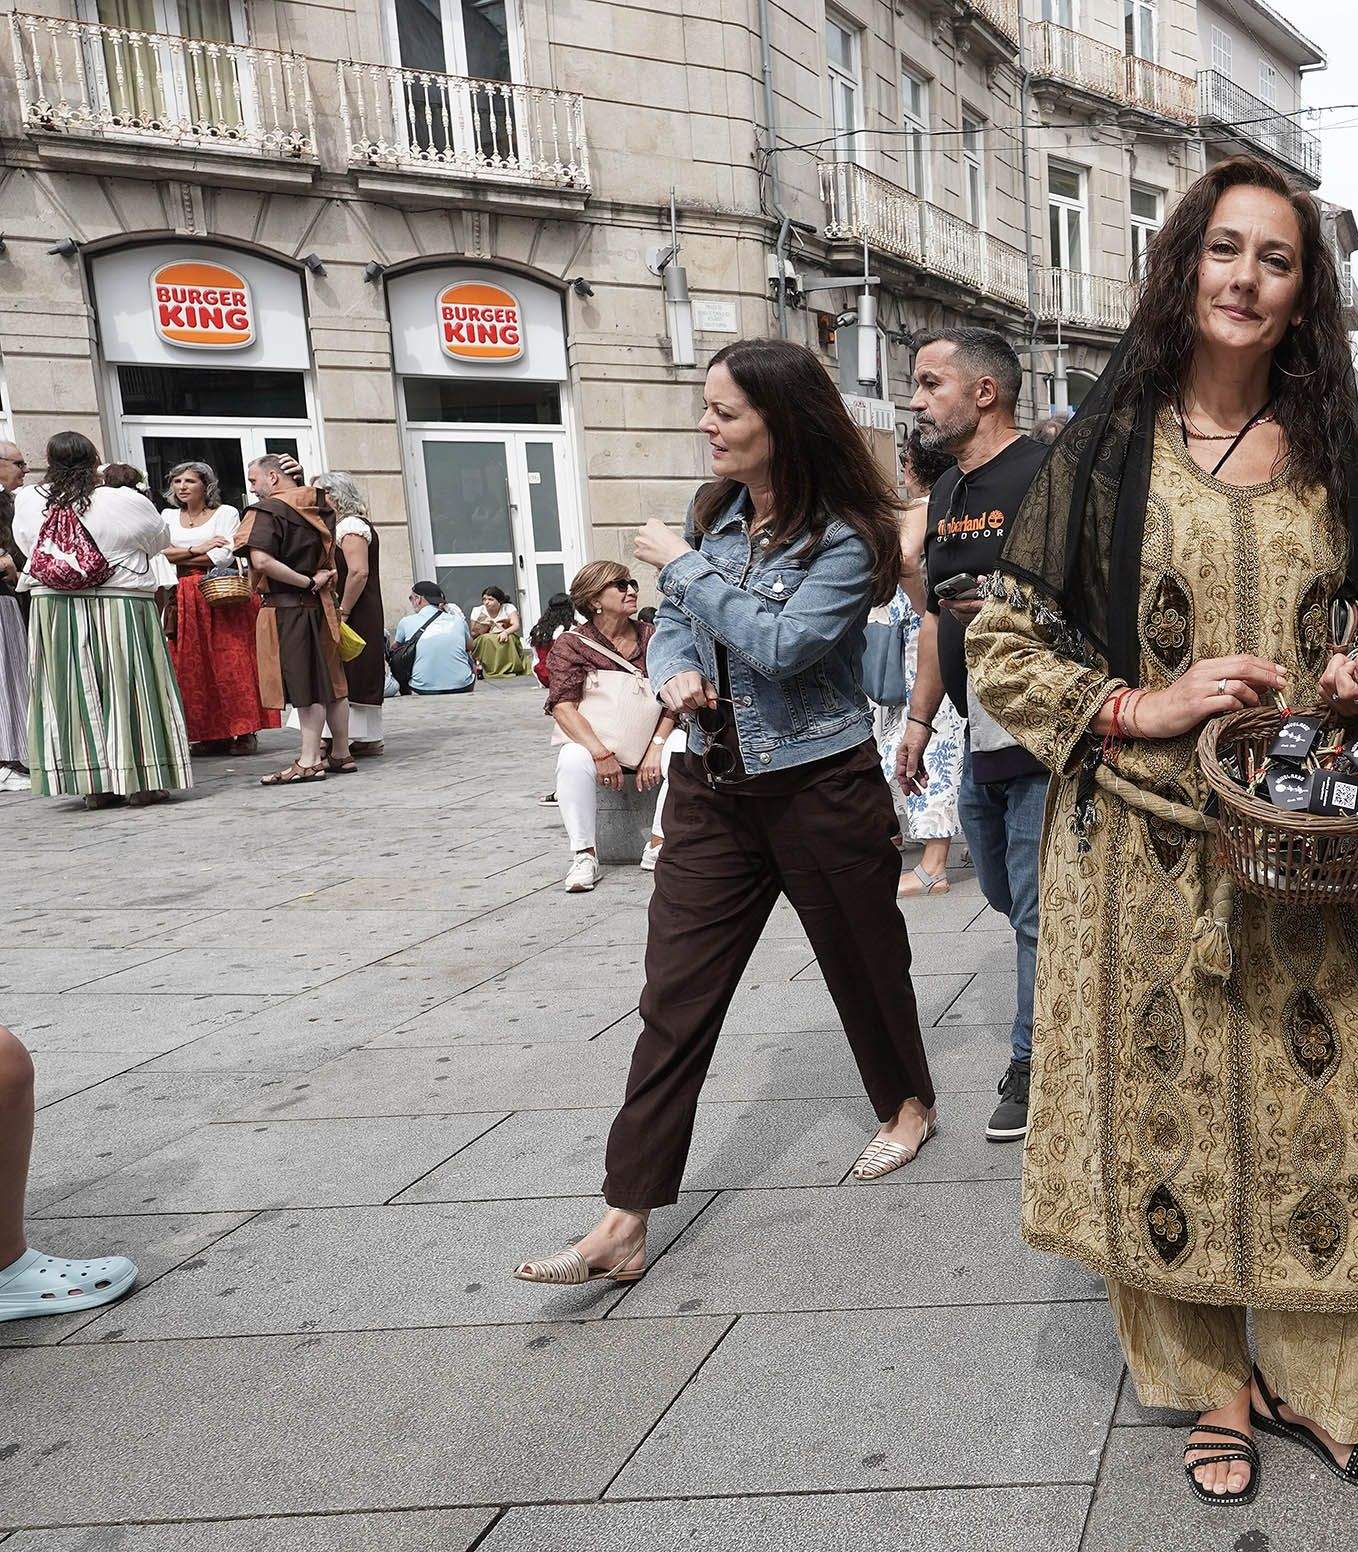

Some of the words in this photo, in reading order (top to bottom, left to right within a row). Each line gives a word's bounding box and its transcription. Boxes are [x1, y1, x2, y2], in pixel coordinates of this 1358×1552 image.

[155, 286, 245, 308] BURGER
[159, 304, 249, 331] KING
[441, 306, 517, 324] BURGER
[443, 322, 520, 345] KING
